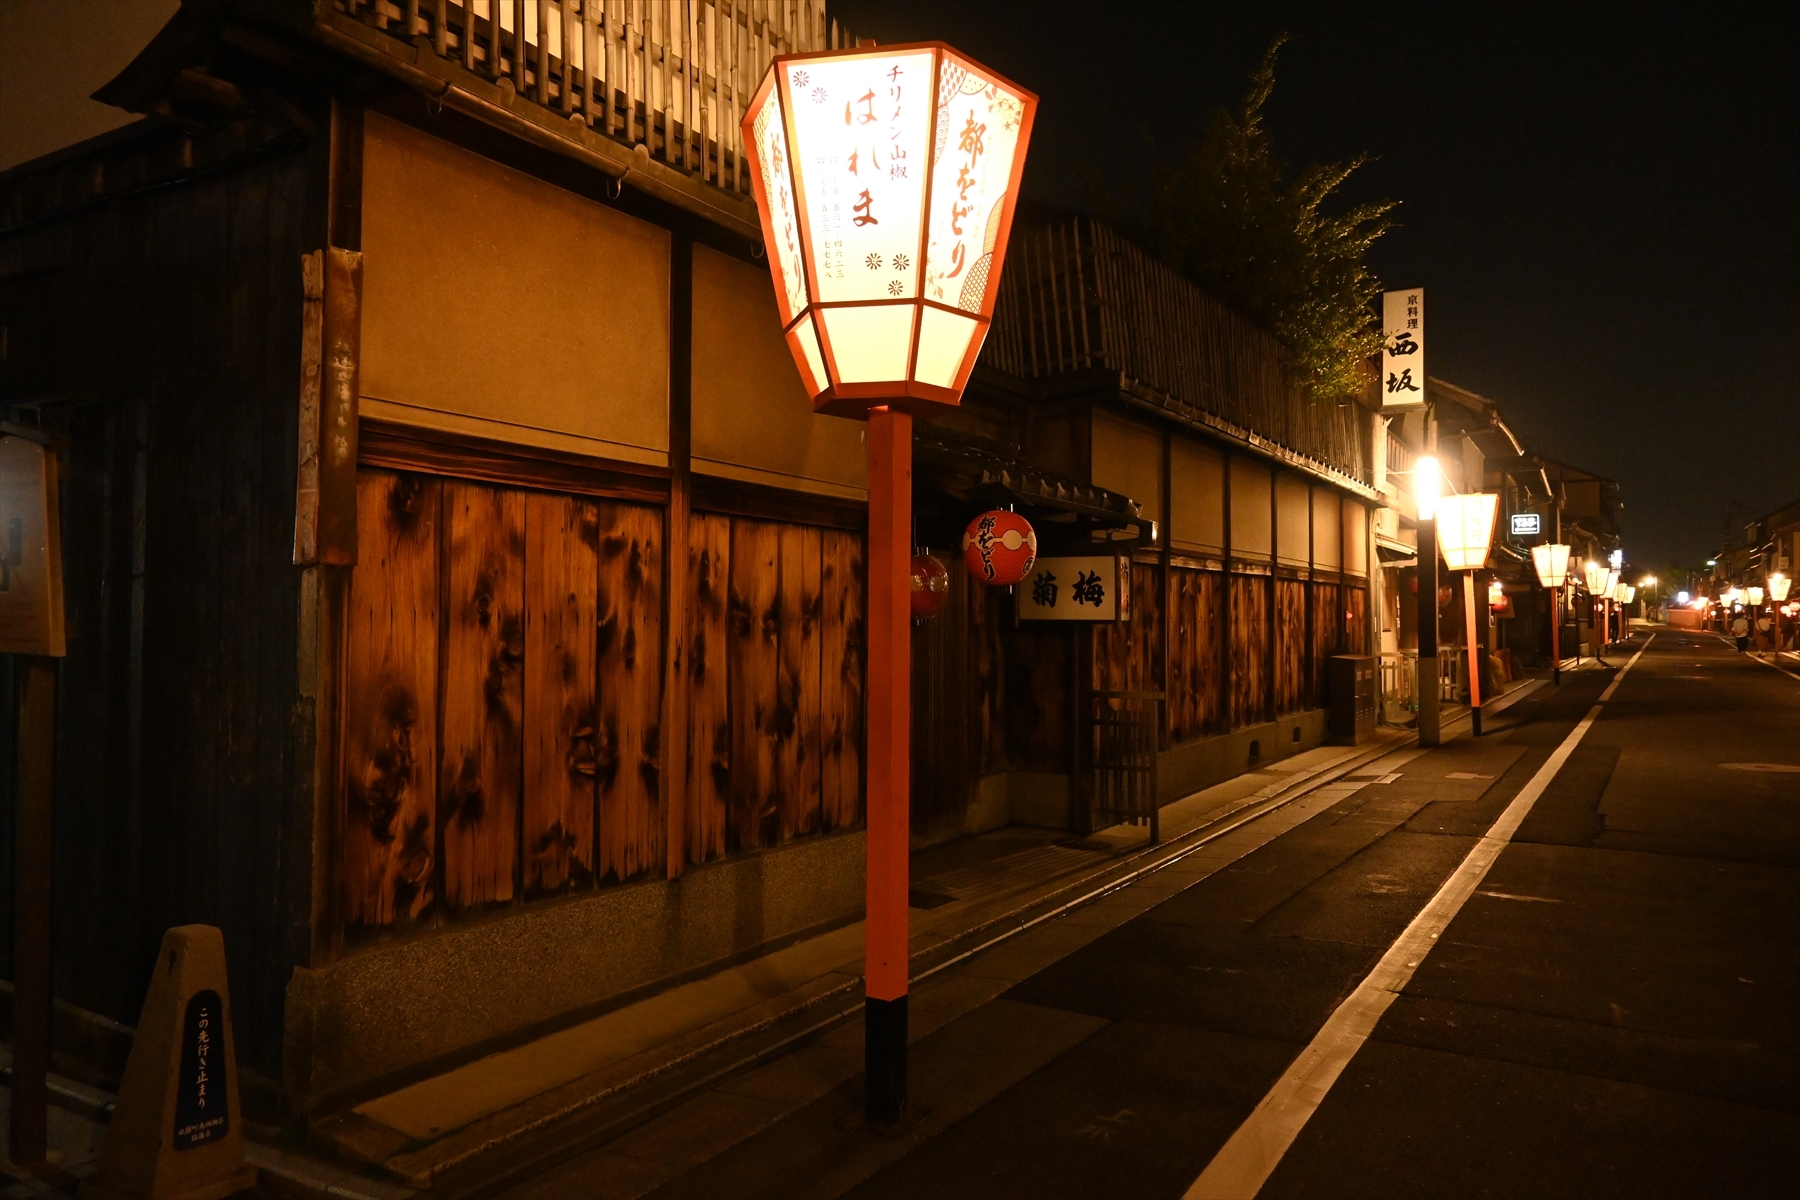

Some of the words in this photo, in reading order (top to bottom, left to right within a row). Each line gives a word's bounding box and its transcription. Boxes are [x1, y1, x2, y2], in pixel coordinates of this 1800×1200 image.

[844, 87, 882, 228] はれま
[946, 109, 988, 279] 都をどり
[1407, 294, 1418, 329] 京料理
[1386, 332, 1420, 393] 西坂
[977, 516, 998, 580] 都をどり
[196, 1007, 210, 1109] この先行き止まり
